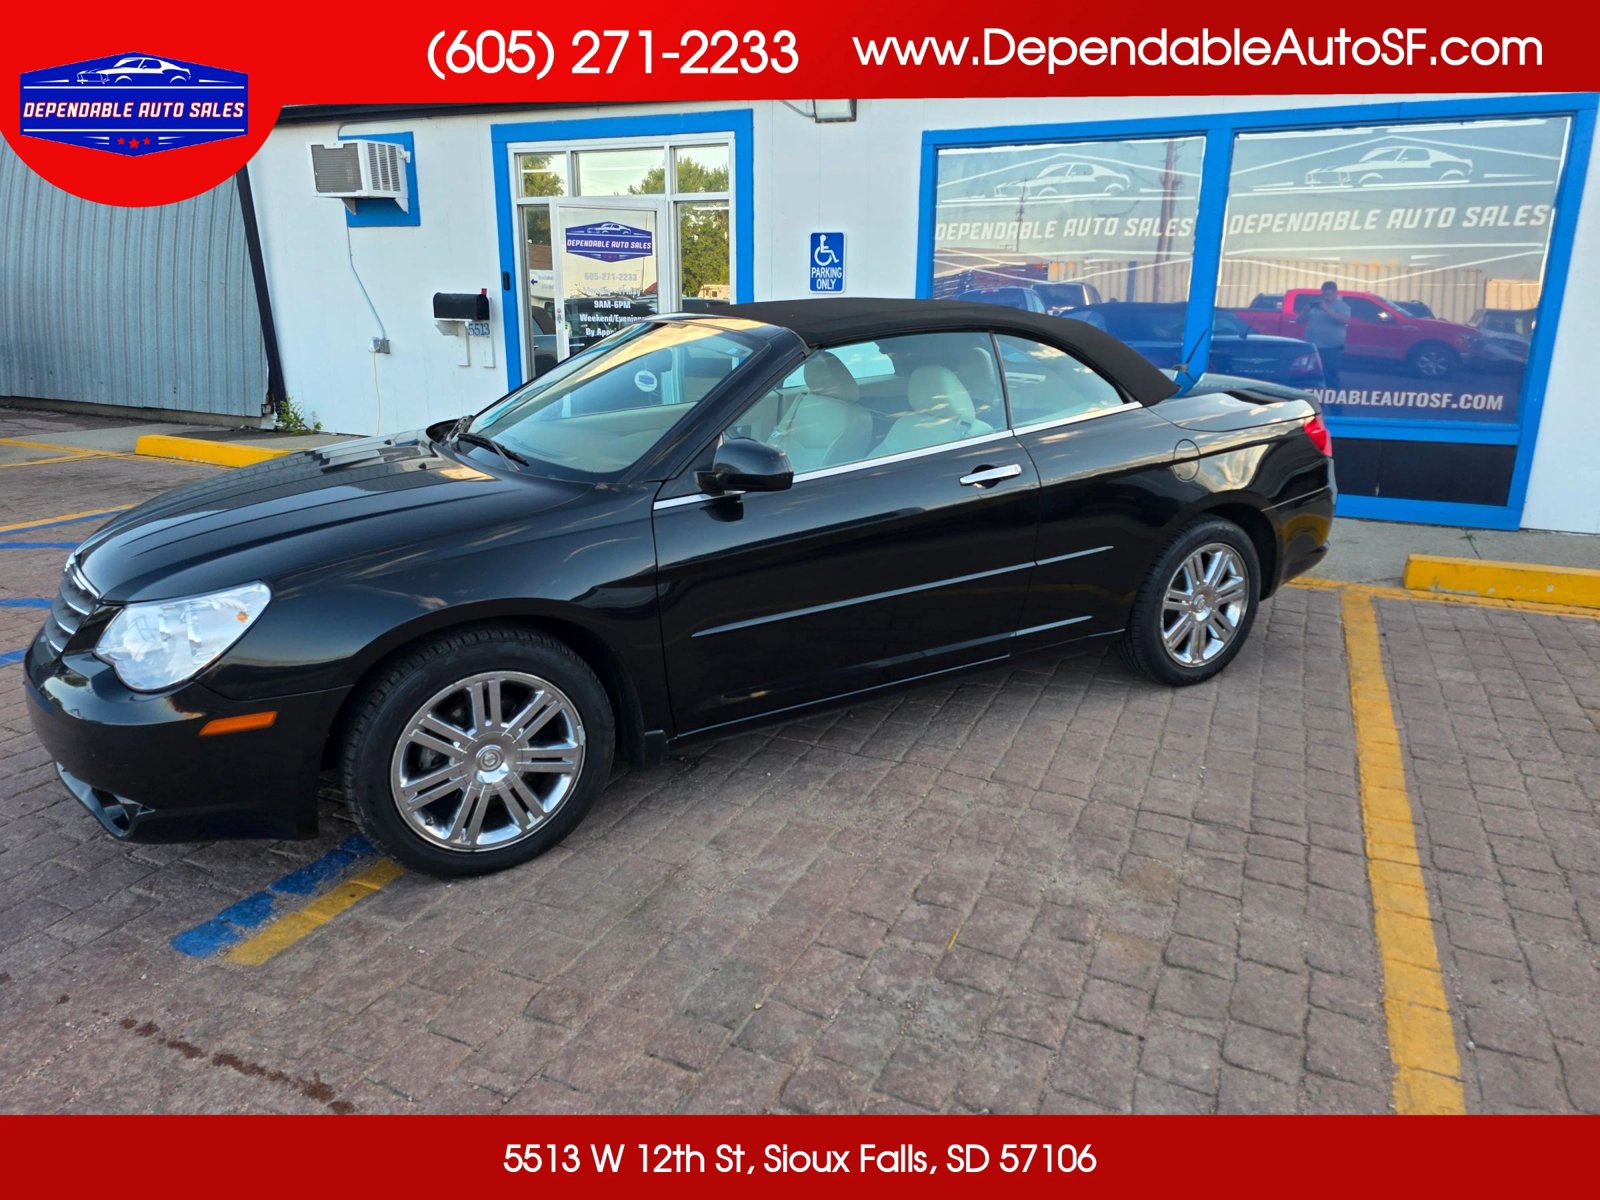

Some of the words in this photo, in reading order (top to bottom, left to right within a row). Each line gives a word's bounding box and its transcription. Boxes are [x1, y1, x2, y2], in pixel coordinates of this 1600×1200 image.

[1229, 209, 1381, 235] DEPENDABLE
[1386, 207, 1457, 229] AUTO
[1462, 204, 1550, 228] SALES
[936, 220, 1058, 241] DEPENDABLE
[1063, 217, 1120, 237] AUTO
[1124, 217, 1194, 237] SALES
[567, 239, 610, 248] DEPENDABLE
[611, 240, 630, 249] AUTO
[630, 241, 652, 250] SALES
[811, 267, 842, 279] PARKING
[816, 278, 837, 290] ONLY
[594, 300, 631, 309] 9AM-6PM
[468, 322, 490, 337] 5513
[586, 328, 595, 337] By
